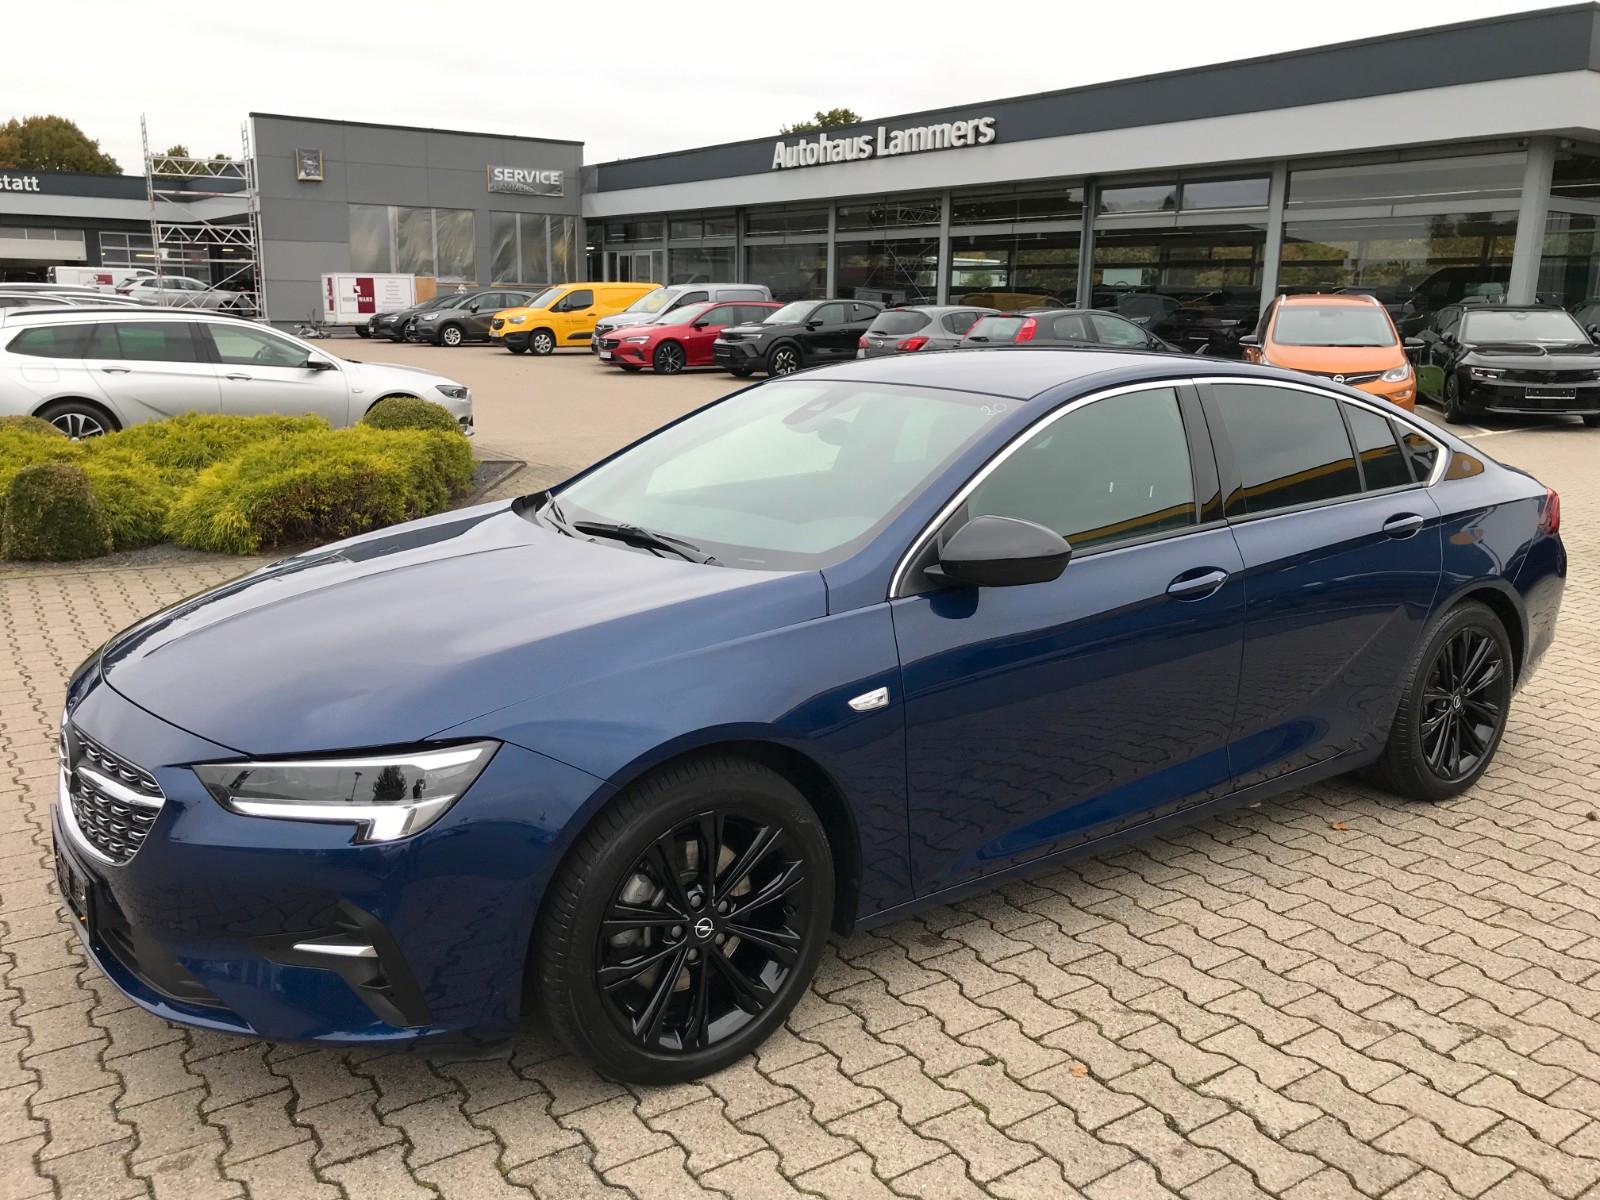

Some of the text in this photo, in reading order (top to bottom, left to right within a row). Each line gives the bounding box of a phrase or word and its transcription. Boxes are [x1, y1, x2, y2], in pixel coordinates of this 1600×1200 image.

[772, 116, 996, 169] Autohaus Lammers
[494, 167, 560, 185] SERVICE
